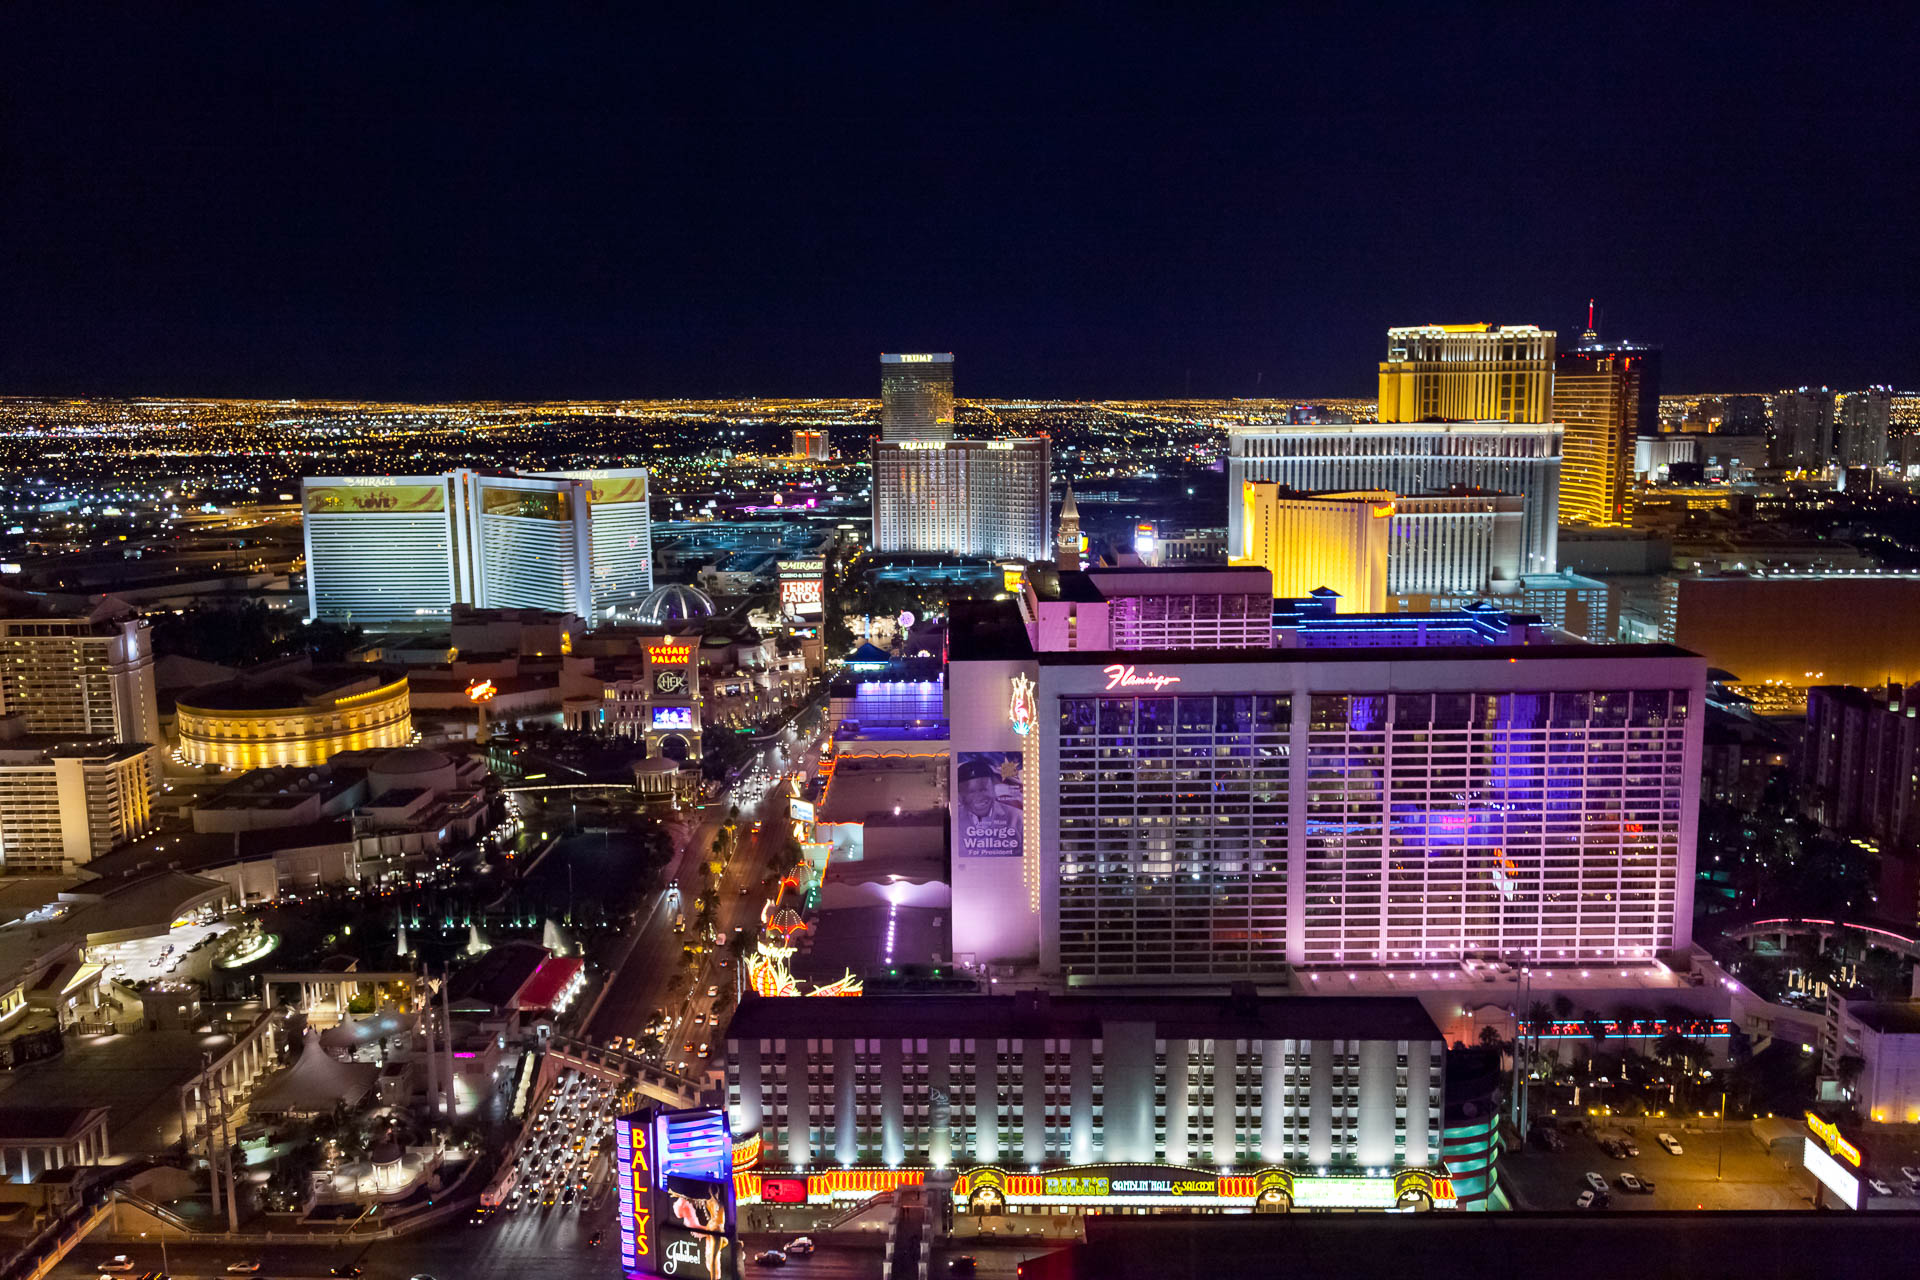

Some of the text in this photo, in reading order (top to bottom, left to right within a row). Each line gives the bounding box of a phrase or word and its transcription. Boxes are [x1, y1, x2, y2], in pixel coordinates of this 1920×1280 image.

[900, 354, 933, 362] TRUMP
[899, 442, 1014, 450] TREASURE ISLAND
[355, 477, 396, 487] MIRAGE
[787, 561, 824, 570] MIRAGE
[781, 582, 821, 592] TERRY
[782, 591, 821, 602] FATOR
[648, 646, 690, 655] CAESARS
[651, 655, 689, 664] PALACE
[657, 671, 686, 692] CHER
[1103, 664, 1181, 691] Flamingo
[966, 826, 1016, 839] George
[964, 838, 1018, 848] Wallace
[1045, 1176, 1109, 1195] BILL'S
[1151, 1180, 1172, 1192] HALL
[1172, 1181, 1183, 1195] &
[1182, 1181, 1215, 1192] SALOON
